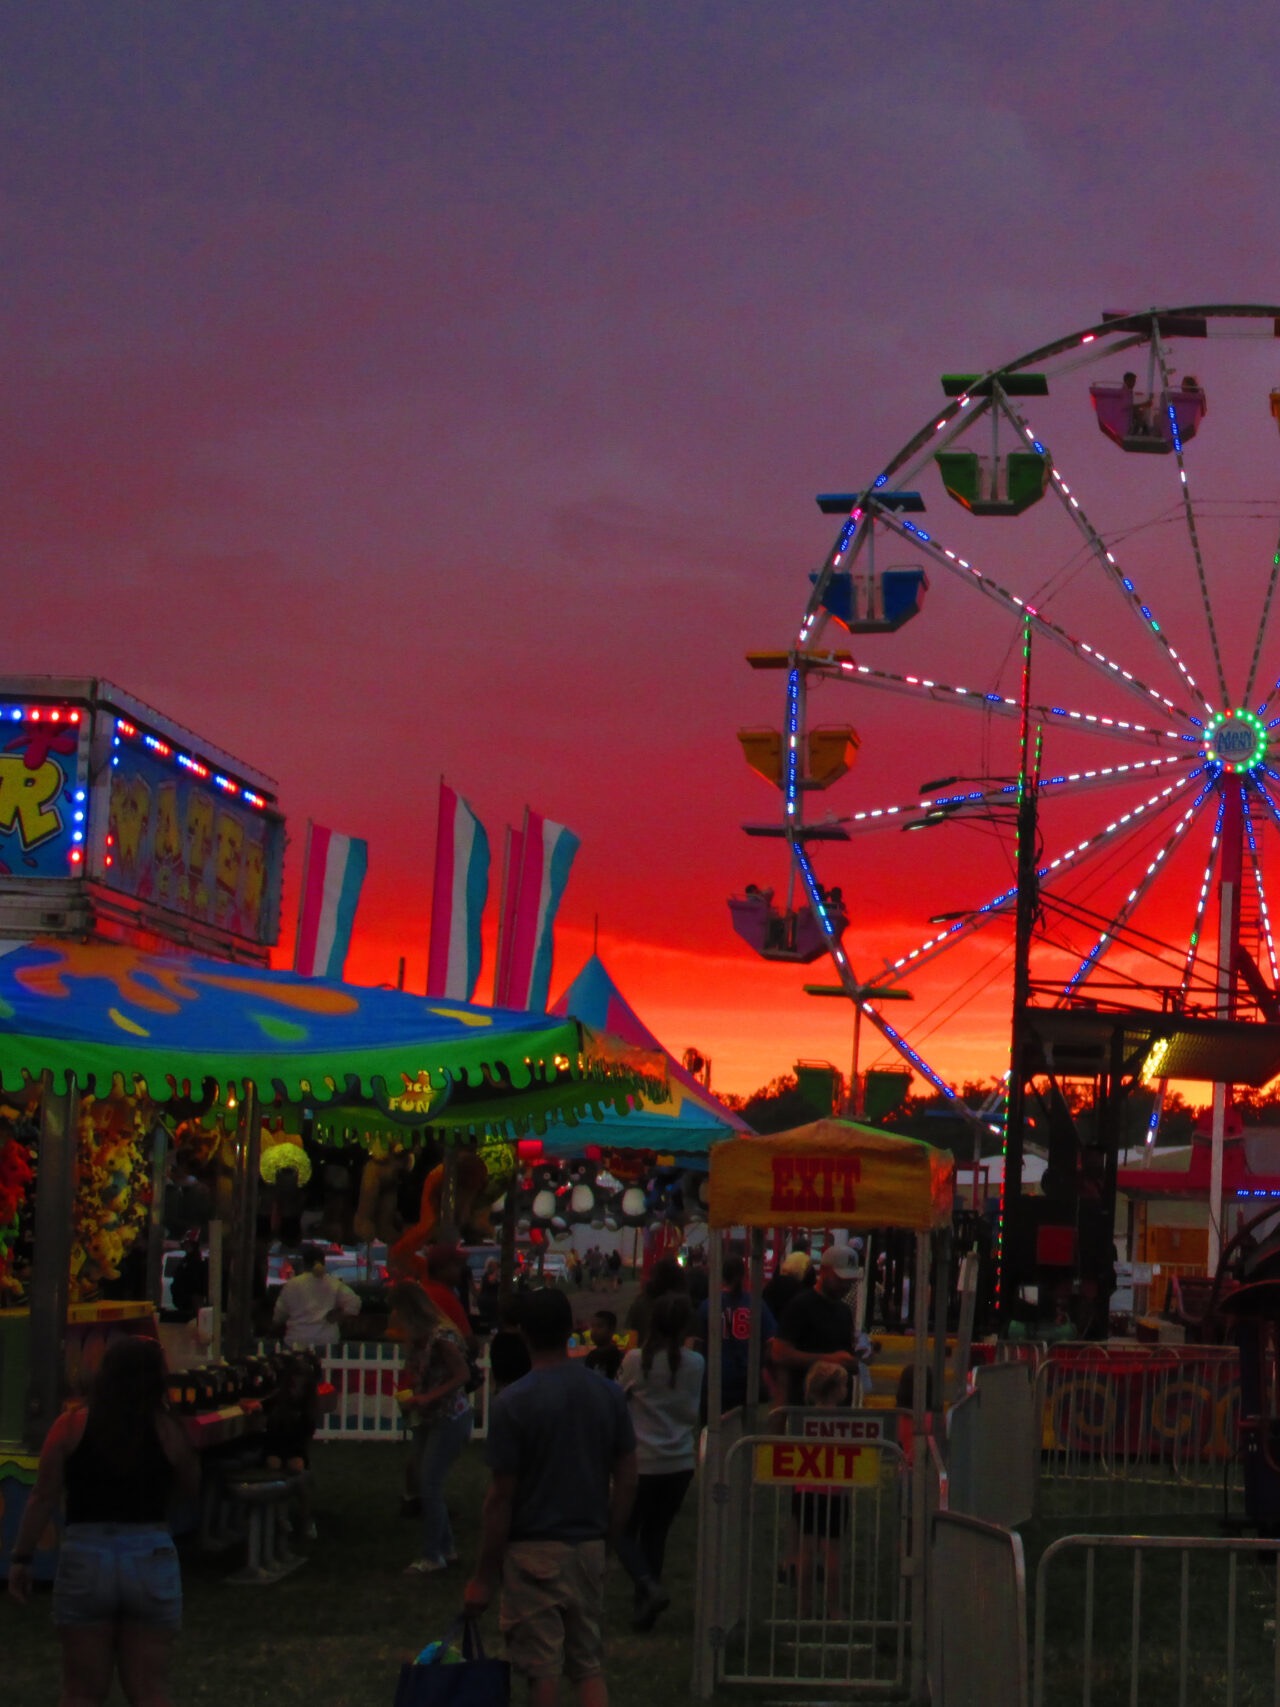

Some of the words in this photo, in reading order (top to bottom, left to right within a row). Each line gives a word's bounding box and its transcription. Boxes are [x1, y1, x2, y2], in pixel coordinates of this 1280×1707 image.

[109, 774, 267, 912] WATER
[388, 1096, 431, 1115] FUN
[770, 1157, 861, 1213] EXIT
[805, 1421, 880, 1438] ENTER
[772, 1445, 861, 1479] EXIT
